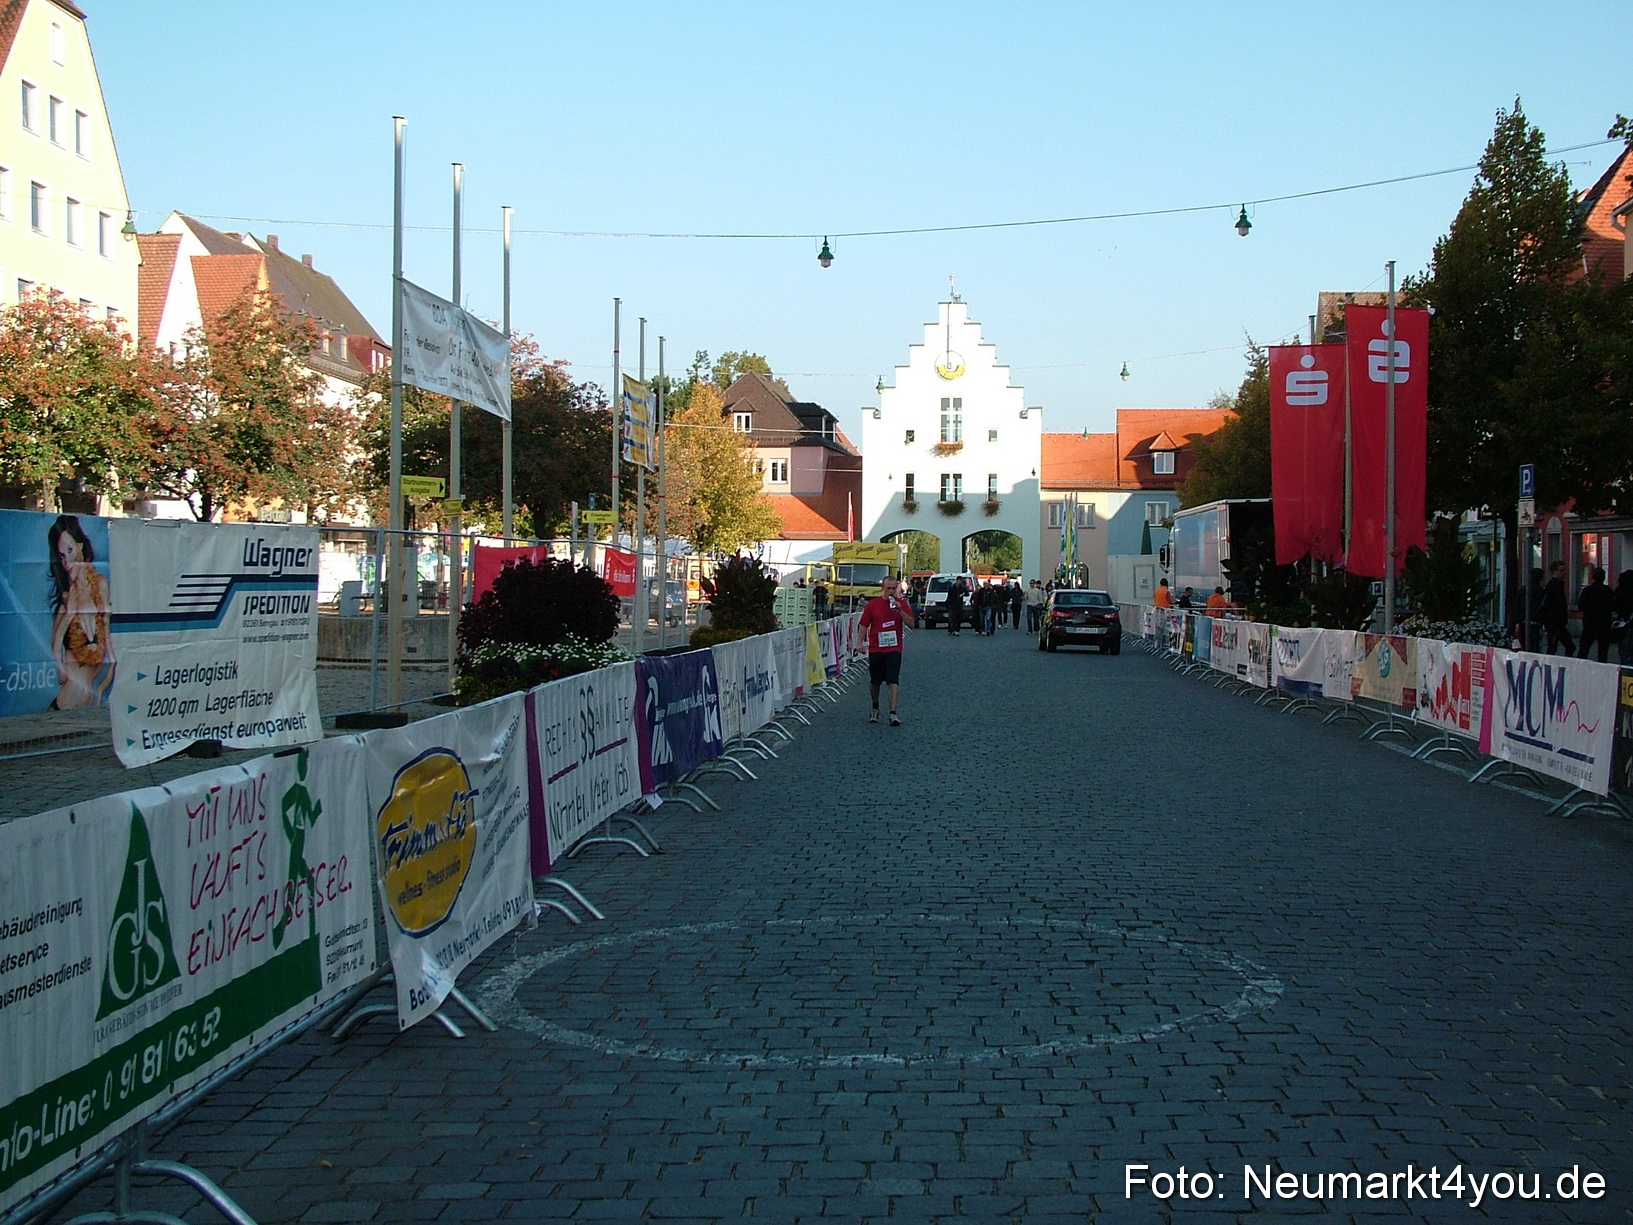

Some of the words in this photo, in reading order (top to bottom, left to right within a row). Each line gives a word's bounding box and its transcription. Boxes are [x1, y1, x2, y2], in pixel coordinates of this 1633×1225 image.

[1522, 469, 1531, 493] P
[243, 538, 313, 576] Wagner
[243, 595, 311, 616] SPEDITION
[155, 660, 239, 689] Lagerlogistik
[147, 697, 177, 718] 1200
[178, 698, 199, 719] qm
[205, 688, 274, 714] Lagerfläche
[1504, 660, 1567, 738] MCM
[142, 721, 235, 750] Expressdienst
[236, 712, 307, 738] europaweit
[228, 772, 267, 830] UNS
[103, 1070, 113, 1111] 0
[142, 1039, 164, 1085] 81
